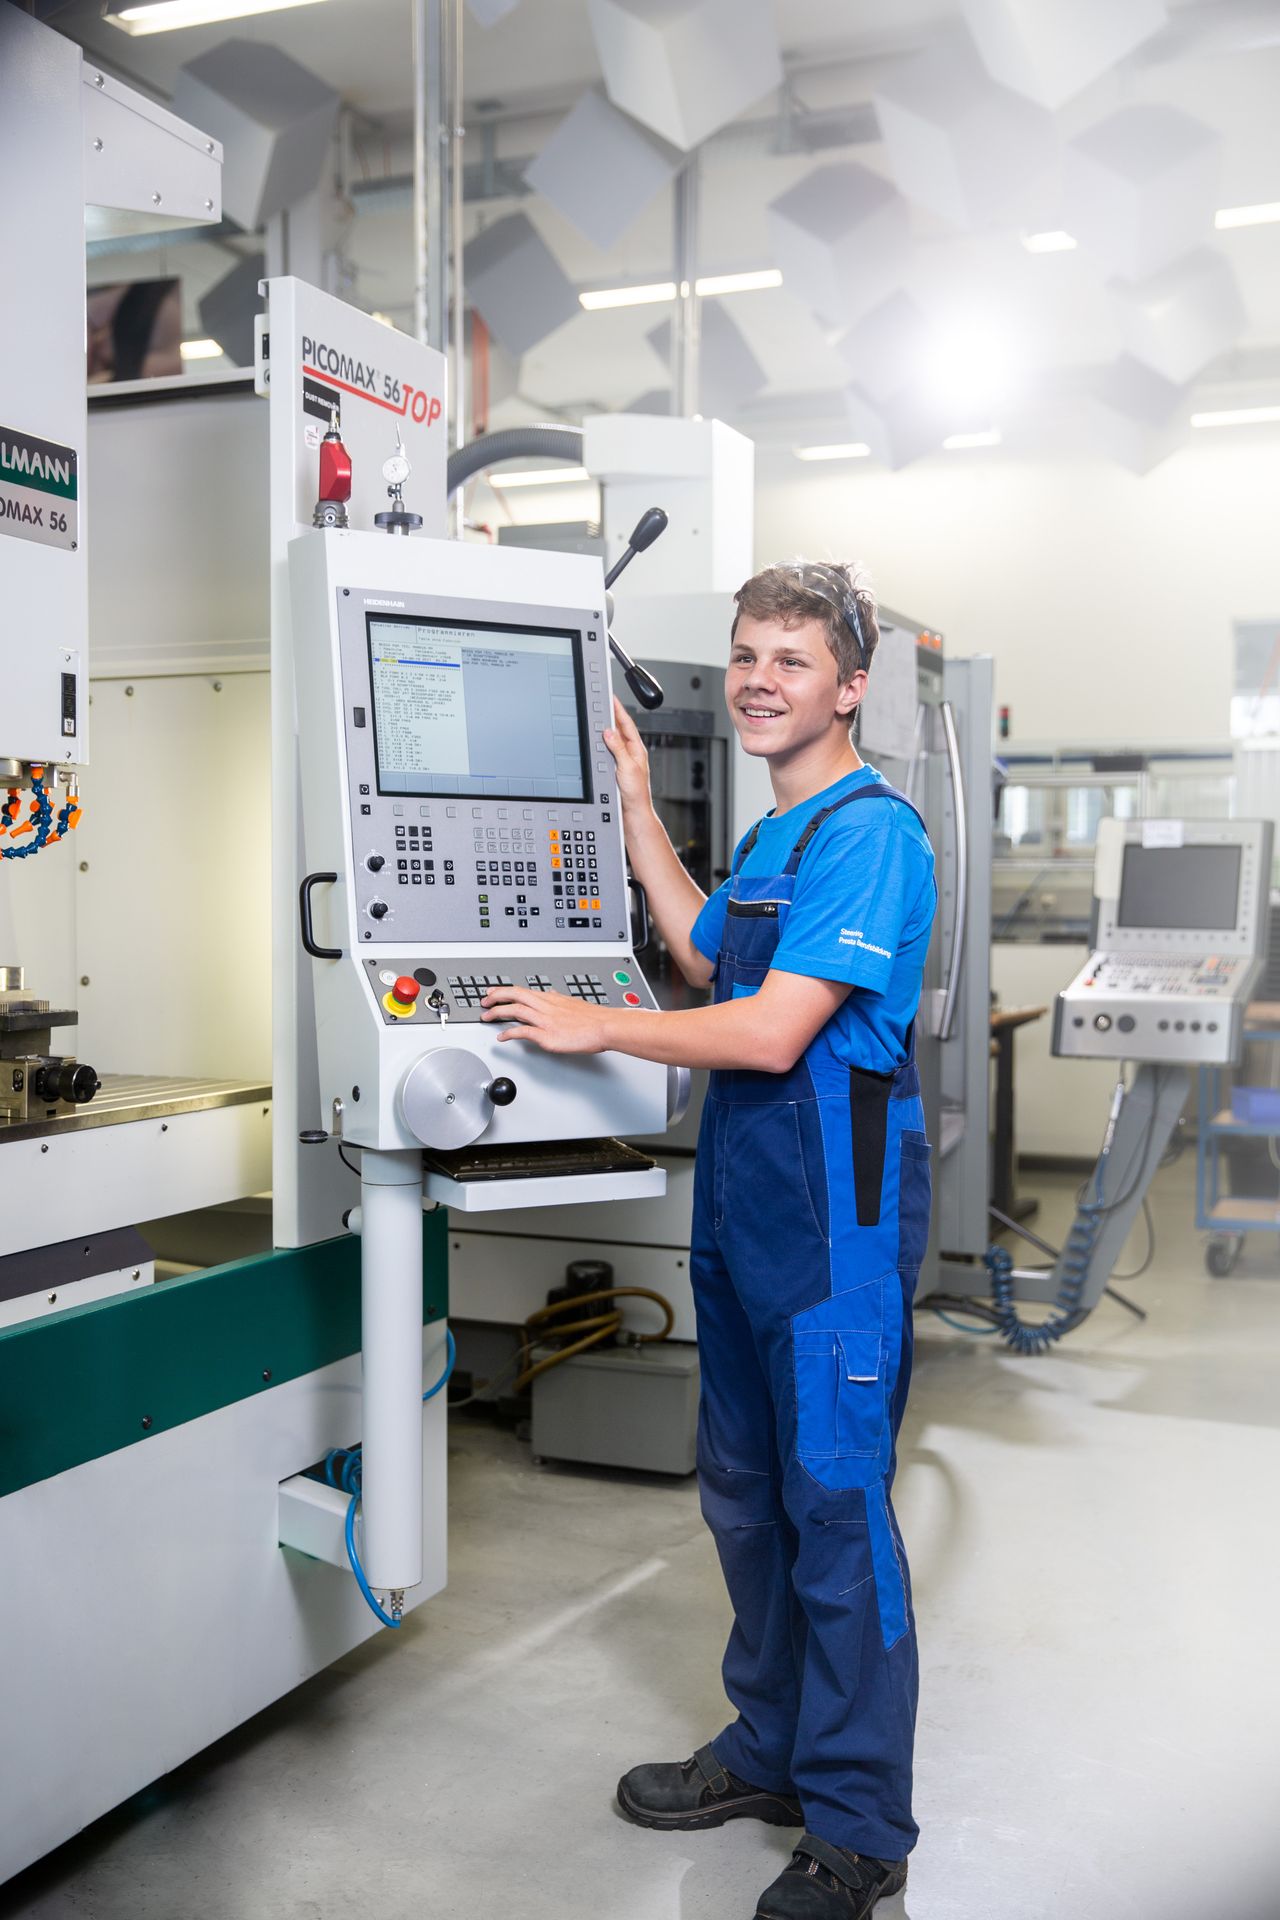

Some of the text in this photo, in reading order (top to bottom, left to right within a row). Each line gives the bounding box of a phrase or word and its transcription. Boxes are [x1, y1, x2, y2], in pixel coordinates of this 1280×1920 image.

[302, 335, 442, 428] PICOMAX 56 TOP
[305, 392, 317, 402] DUST
[1, 441, 70, 486] LMANN
[49, 510, 67, 533] 56
[363, 598, 405, 608] HEIDENHAIN
